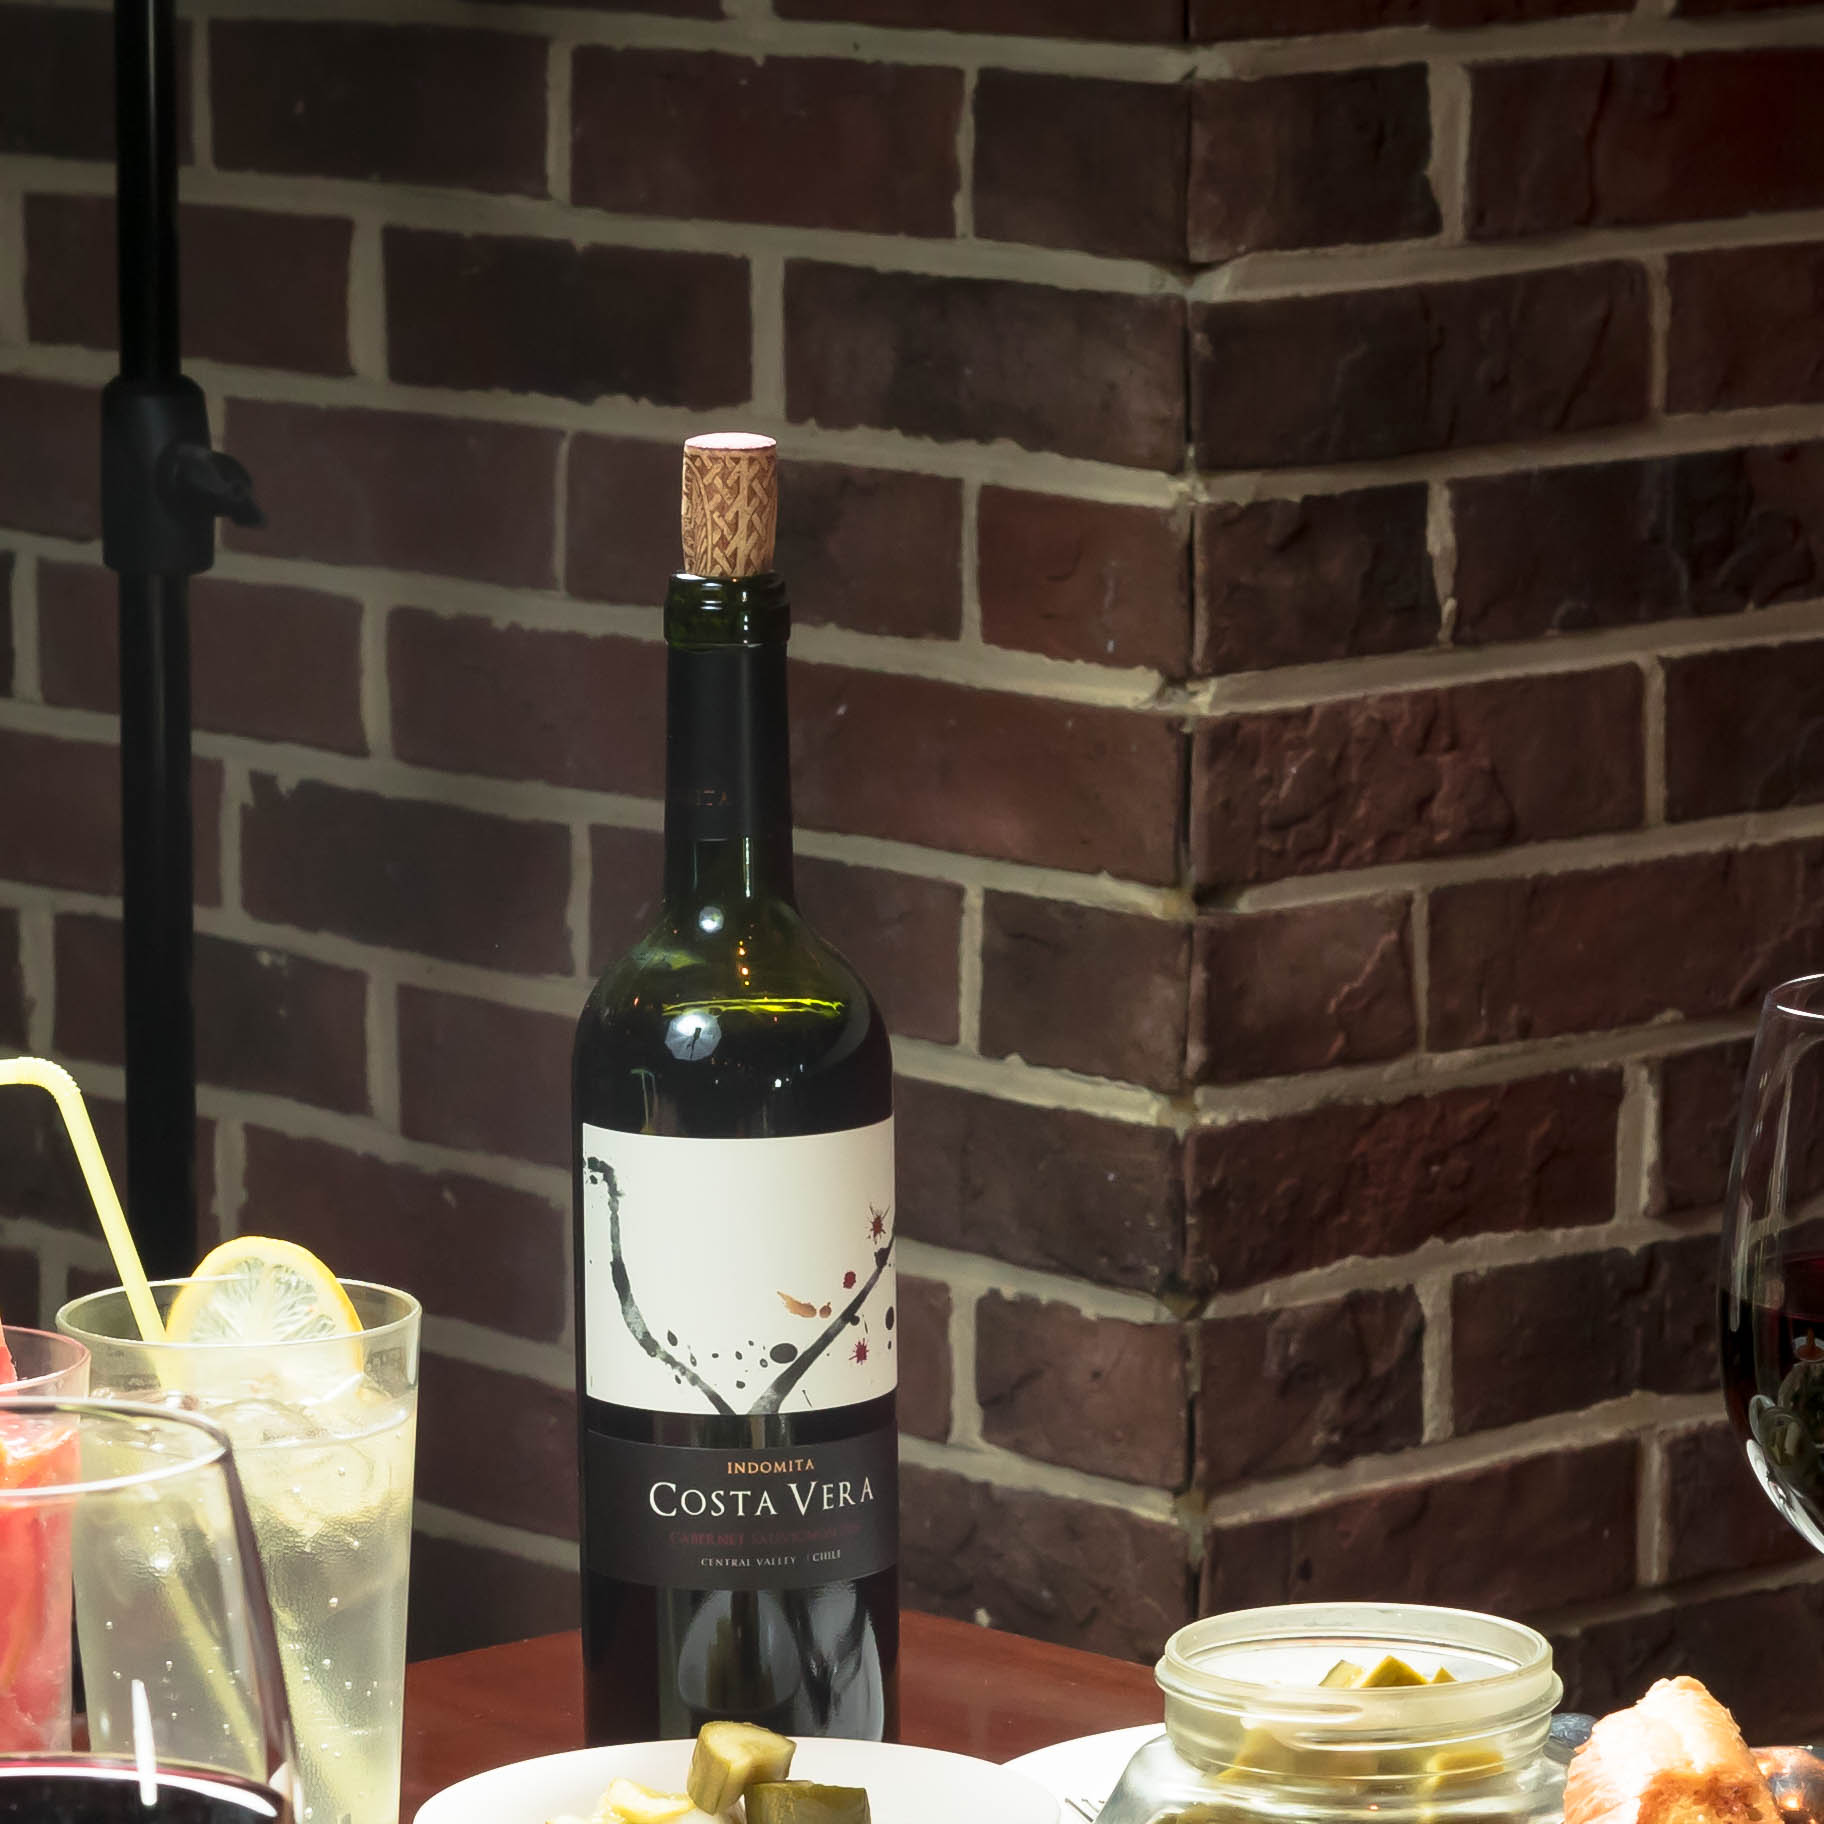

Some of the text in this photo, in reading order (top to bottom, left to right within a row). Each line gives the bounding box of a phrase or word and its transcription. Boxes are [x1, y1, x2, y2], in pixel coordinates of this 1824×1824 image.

[727, 1458, 815, 1475] INDOMITA
[648, 1475, 874, 1518] COSTA VERA
[701, 1548, 842, 1568] CENTRAL VALLEY CHILE
